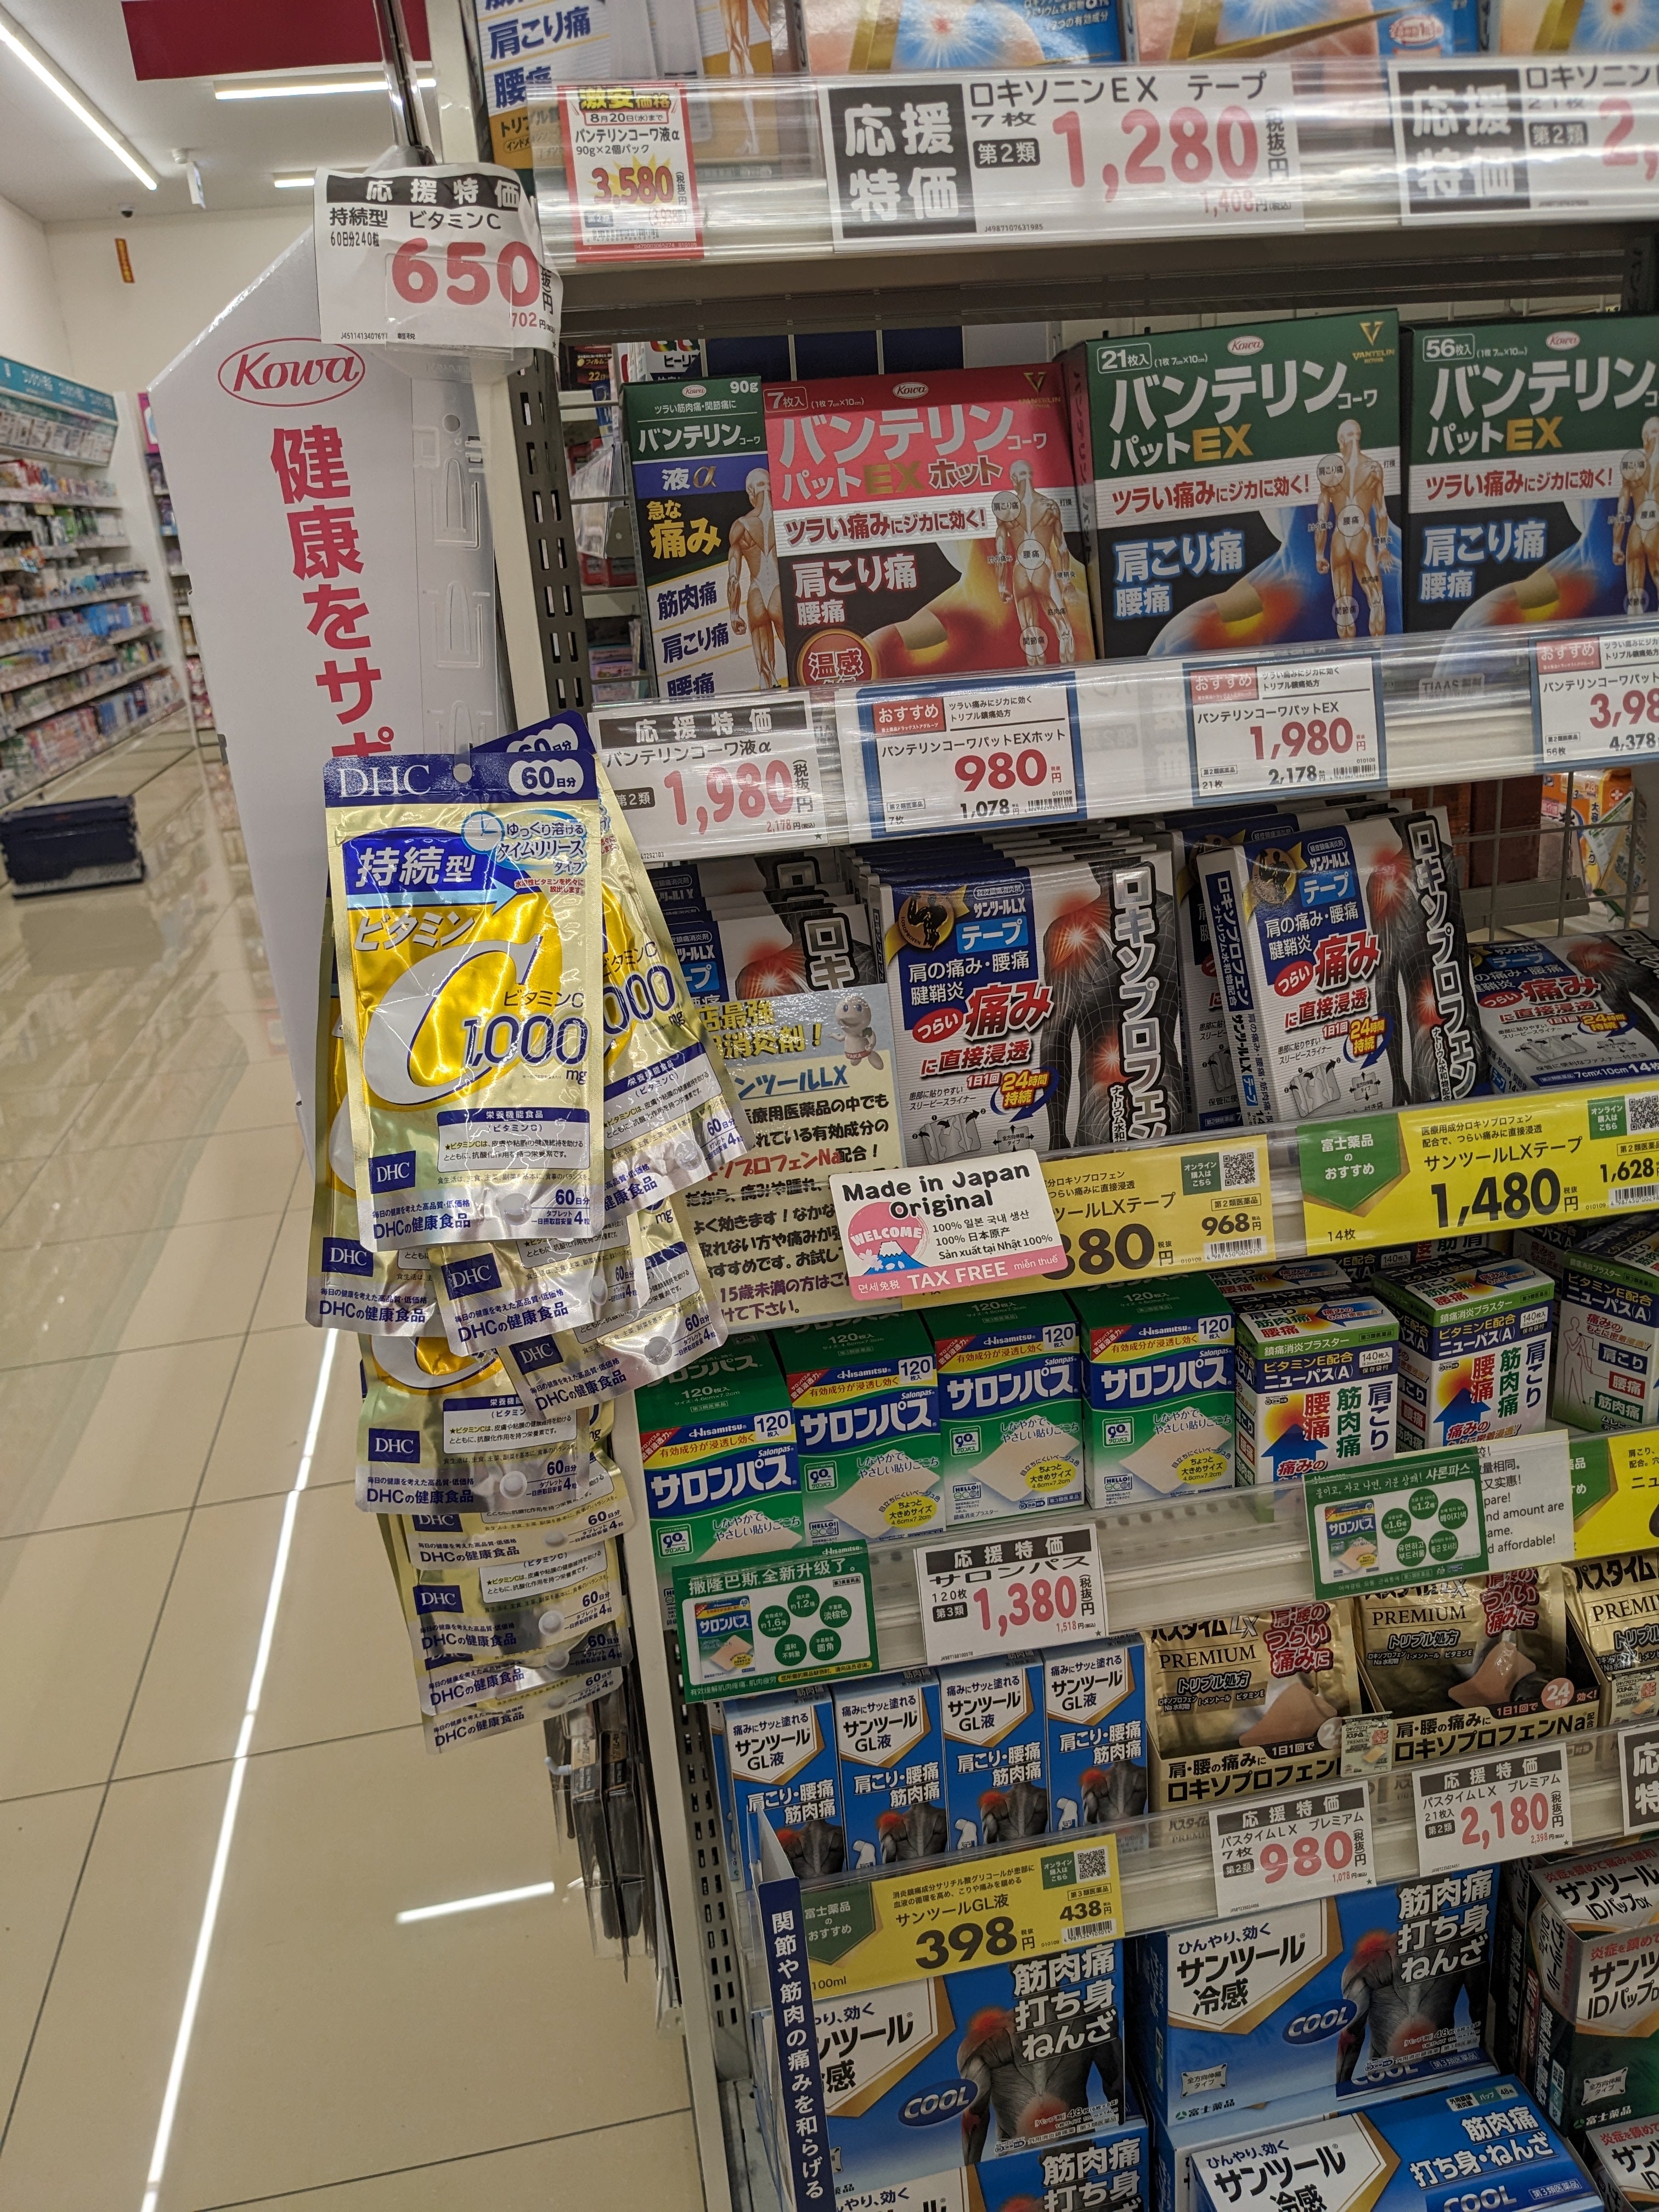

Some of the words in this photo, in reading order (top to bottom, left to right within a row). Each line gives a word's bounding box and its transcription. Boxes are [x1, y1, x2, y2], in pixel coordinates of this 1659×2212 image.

[489, 6, 591, 59] 肩こり痛
[1188, 70, 1267, 100] テープ
[978, 143, 1036, 164] 第2類
[1053, 105, 1259, 202] 1,280
[591, 166, 674, 208] 3,580
[330, 207, 388, 228] 持続型
[409, 211, 501, 230] ビタミンC
[392, 238, 540, 307] 650
[512, 312, 537, 328] 702
[1231, 340, 1262, 351] Kowa
[233, 349, 359, 391] Kowa
[730, 380, 758, 394] 90g
[897, 385, 926, 395] Kowa
[647, 500, 681, 521] 急な
[650, 517, 721, 560] 痛み
[1424, 521, 1545, 566] 肩こり痛
[1116, 531, 1243, 583] 肩こり痛
[793, 554, 917, 598] 肩こり痛
[1421, 571, 1472, 601] 腰痛
[657, 581, 717, 620] 筋肉痛
[797, 600, 845, 627] 腰痛
[1116, 584, 1170, 617] 腰痛
[662, 623, 729, 663] 肩こり痛
[1541, 645, 1594, 661] おすすめ
[1195, 674, 1252, 691] おすすめ
[878, 704, 939, 723] おすすめ
[1250, 718, 1353, 760] 1,980
[1547, 747, 1566, 755] 56枚
[1610, 732, 1656, 751] 4,378
[340, 765, 431, 797] DHC
[522, 766, 576, 789] 60日分
[955, 749, 1047, 792] 980
[1268, 765, 1317, 785] 2,178
[664, 760, 794, 834] 1,980
[1203, 781, 1223, 789] 21枚
[961, 799, 1009, 819] 1,078
[356, 847, 475, 887] 持続型
[1304, 873, 1349, 904] テープ
[353, 912, 475, 952] ビタミン
[961, 919, 1023, 951] テープ
[1314, 932, 1382, 992] 痛み
[504, 991, 584, 1007] ビタミンC
[964, 980, 1053, 1042] 痛み
[917, 1012, 960, 1040] つらい
[566, 1068, 586, 1084] mg
[1321, 1133, 1373, 1153] 富士薬品
[377, 1163, 410, 1182] DHC
[842, 1180, 911, 1202] Made
[919, 1175, 943, 1193] in
[952, 1164, 1030, 1188] Japan
[1324, 1163, 1375, 1181] おすすめ
[1600, 1158, 1654, 1183] 1,628
[555, 1189, 590, 1205] 60日分
[890, 1190, 994, 1219] Original
[1431, 1167, 1561, 1229] 1,480
[373, 1212, 471, 1239] DHCの健康食品
[932, 1220, 962, 1233] 100%
[964, 1217, 984, 1229] 일본
[986, 1214, 1007, 1224] 국내
[1009, 1209, 1029, 1221] 생산
[1201, 1213, 1250, 1236] 968
[850, 1225, 923, 1246] WELCOME
[936, 1234, 965, 1246] 100%
[939, 1249, 958, 1261] Sản
[960, 1244, 980, 1258] xuất
[982, 1244, 996, 1256] tại
[997, 1239, 1022, 1254] Nhật
[1024, 1234, 1053, 1246] 100%
[1327, 1229, 1356, 1243] 14枚
[907, 1269, 951, 1290] TAX
[955, 1261, 1008, 1283] FREE
[1013, 1257, 1036, 1271] miễn
[1038, 1252, 1058, 1266] thuế
[1044, 1327, 1074, 1342] 120
[1199, 1318, 1229, 1334] 120
[1264, 1351, 1354, 1373] ビタミンE配合
[947, 1365, 1076, 1410] サロンパス
[1101, 1356, 1228, 1401] サロンパス
[801, 1398, 932, 1446] サロンパス
[1303, 1390, 1331, 1441] 腰痛
[1336, 1385, 1361, 1459] 筋肉痛
[1368, 1380, 1393, 1451] 肩こり
[651, 1454, 792, 1509] サロンパス
[1503, 1504, 1544, 1519] amount
[1548, 1503, 1564, 1512] are
[1498, 1534, 1555, 1552] affordable!
[929, 1555, 1090, 1588] サロンパス
[932, 1588, 967, 1603] 120枚
[973, 1575, 1077, 1637] 1,380
[936, 1605, 964, 1619] 第3類
[1373, 1605, 1466, 1626] PREMIUM
[1056, 1621, 1077, 1633] 1,518
[1159, 1644, 1256, 1669] PREMIUM
[992, 1762, 1042, 1787] 筋肉痛
[1460, 1791, 1548, 1850] 2,180
[1259, 1830, 1353, 1884] 980
[1398, 1868, 1493, 1920] 筋肉痛
[804, 1901, 851, 1920] 富士薬品
[1059, 1899, 1103, 1922] 438
[808, 1923, 853, 1941] おすすめ
[915, 1916, 1018, 1970] 398
[1176, 1933, 1306, 1988] サンツール
[1192, 1978, 1249, 2017] 冷感
[1022, 2008, 1116, 2063] ねんざ
[1287, 2007, 1349, 2038] COOL
